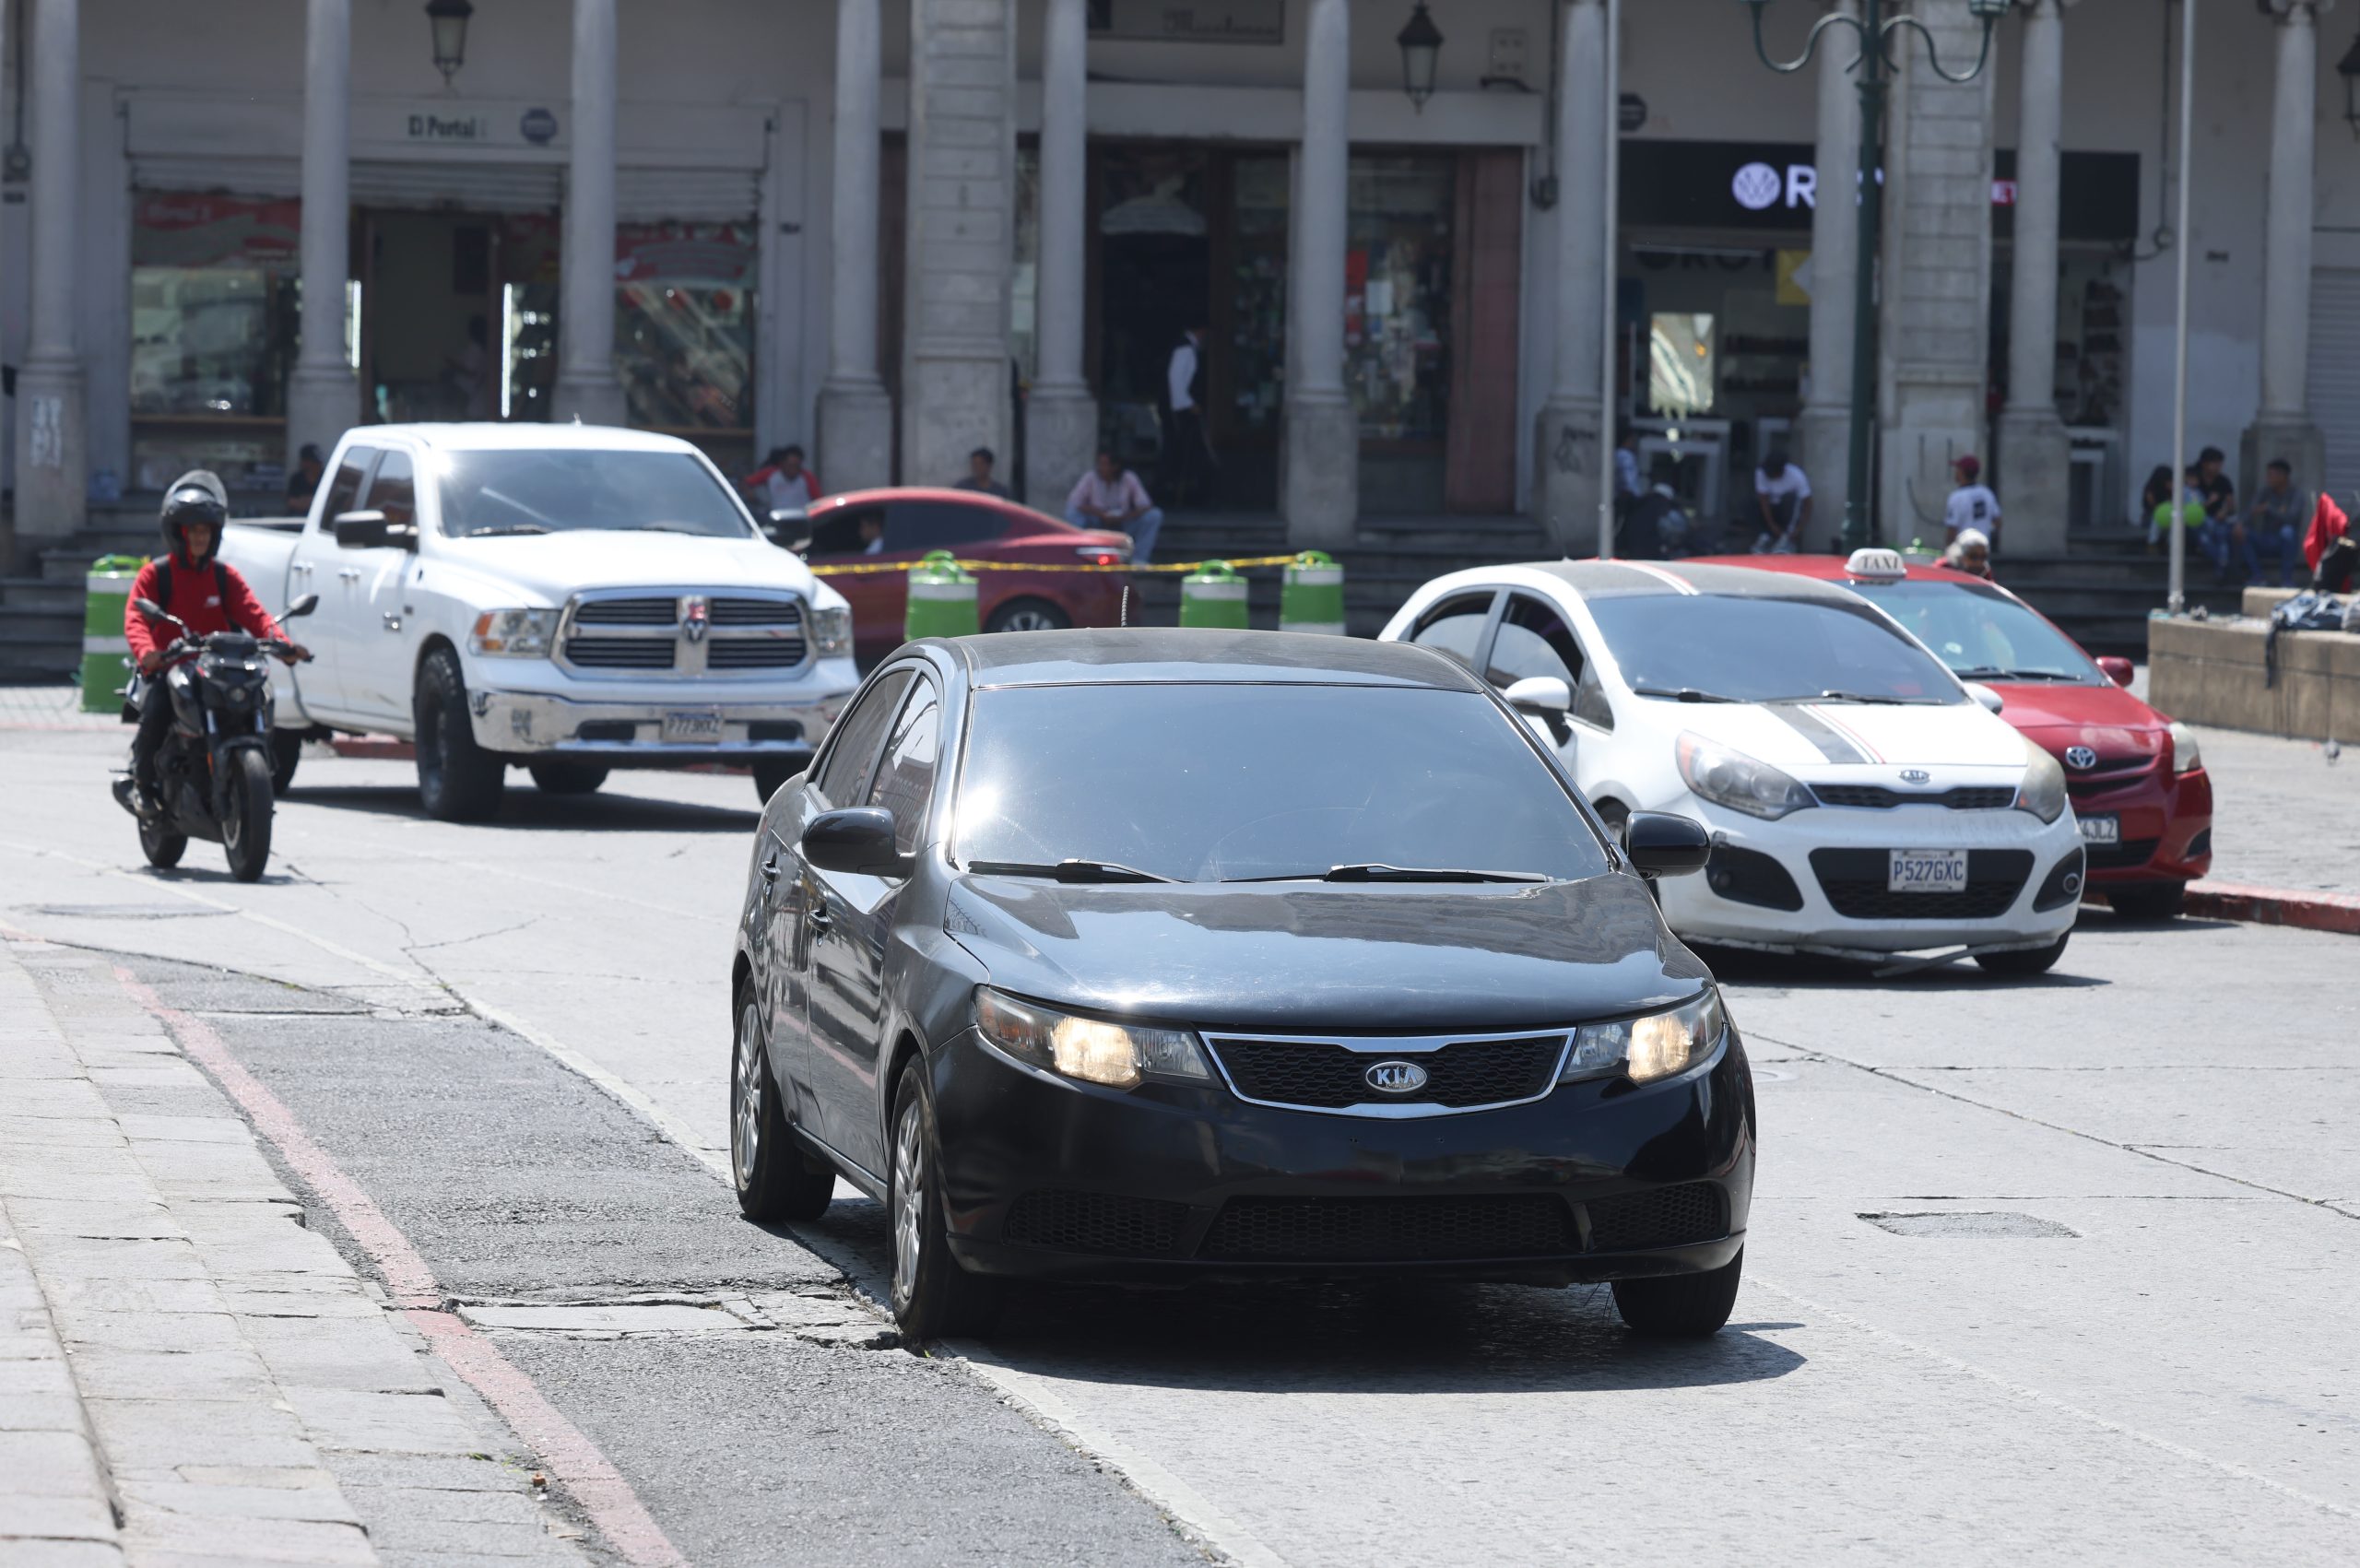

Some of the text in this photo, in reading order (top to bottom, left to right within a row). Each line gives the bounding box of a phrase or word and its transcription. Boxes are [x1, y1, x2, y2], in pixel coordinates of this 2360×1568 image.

[427, 114, 476, 137] Portal
[1861, 555, 1899, 570] TAXI
[2079, 819, 2116, 840] 4JLZ
[1894, 860, 1964, 881] P527GXC
[1375, 1067, 1418, 1085] KIA
